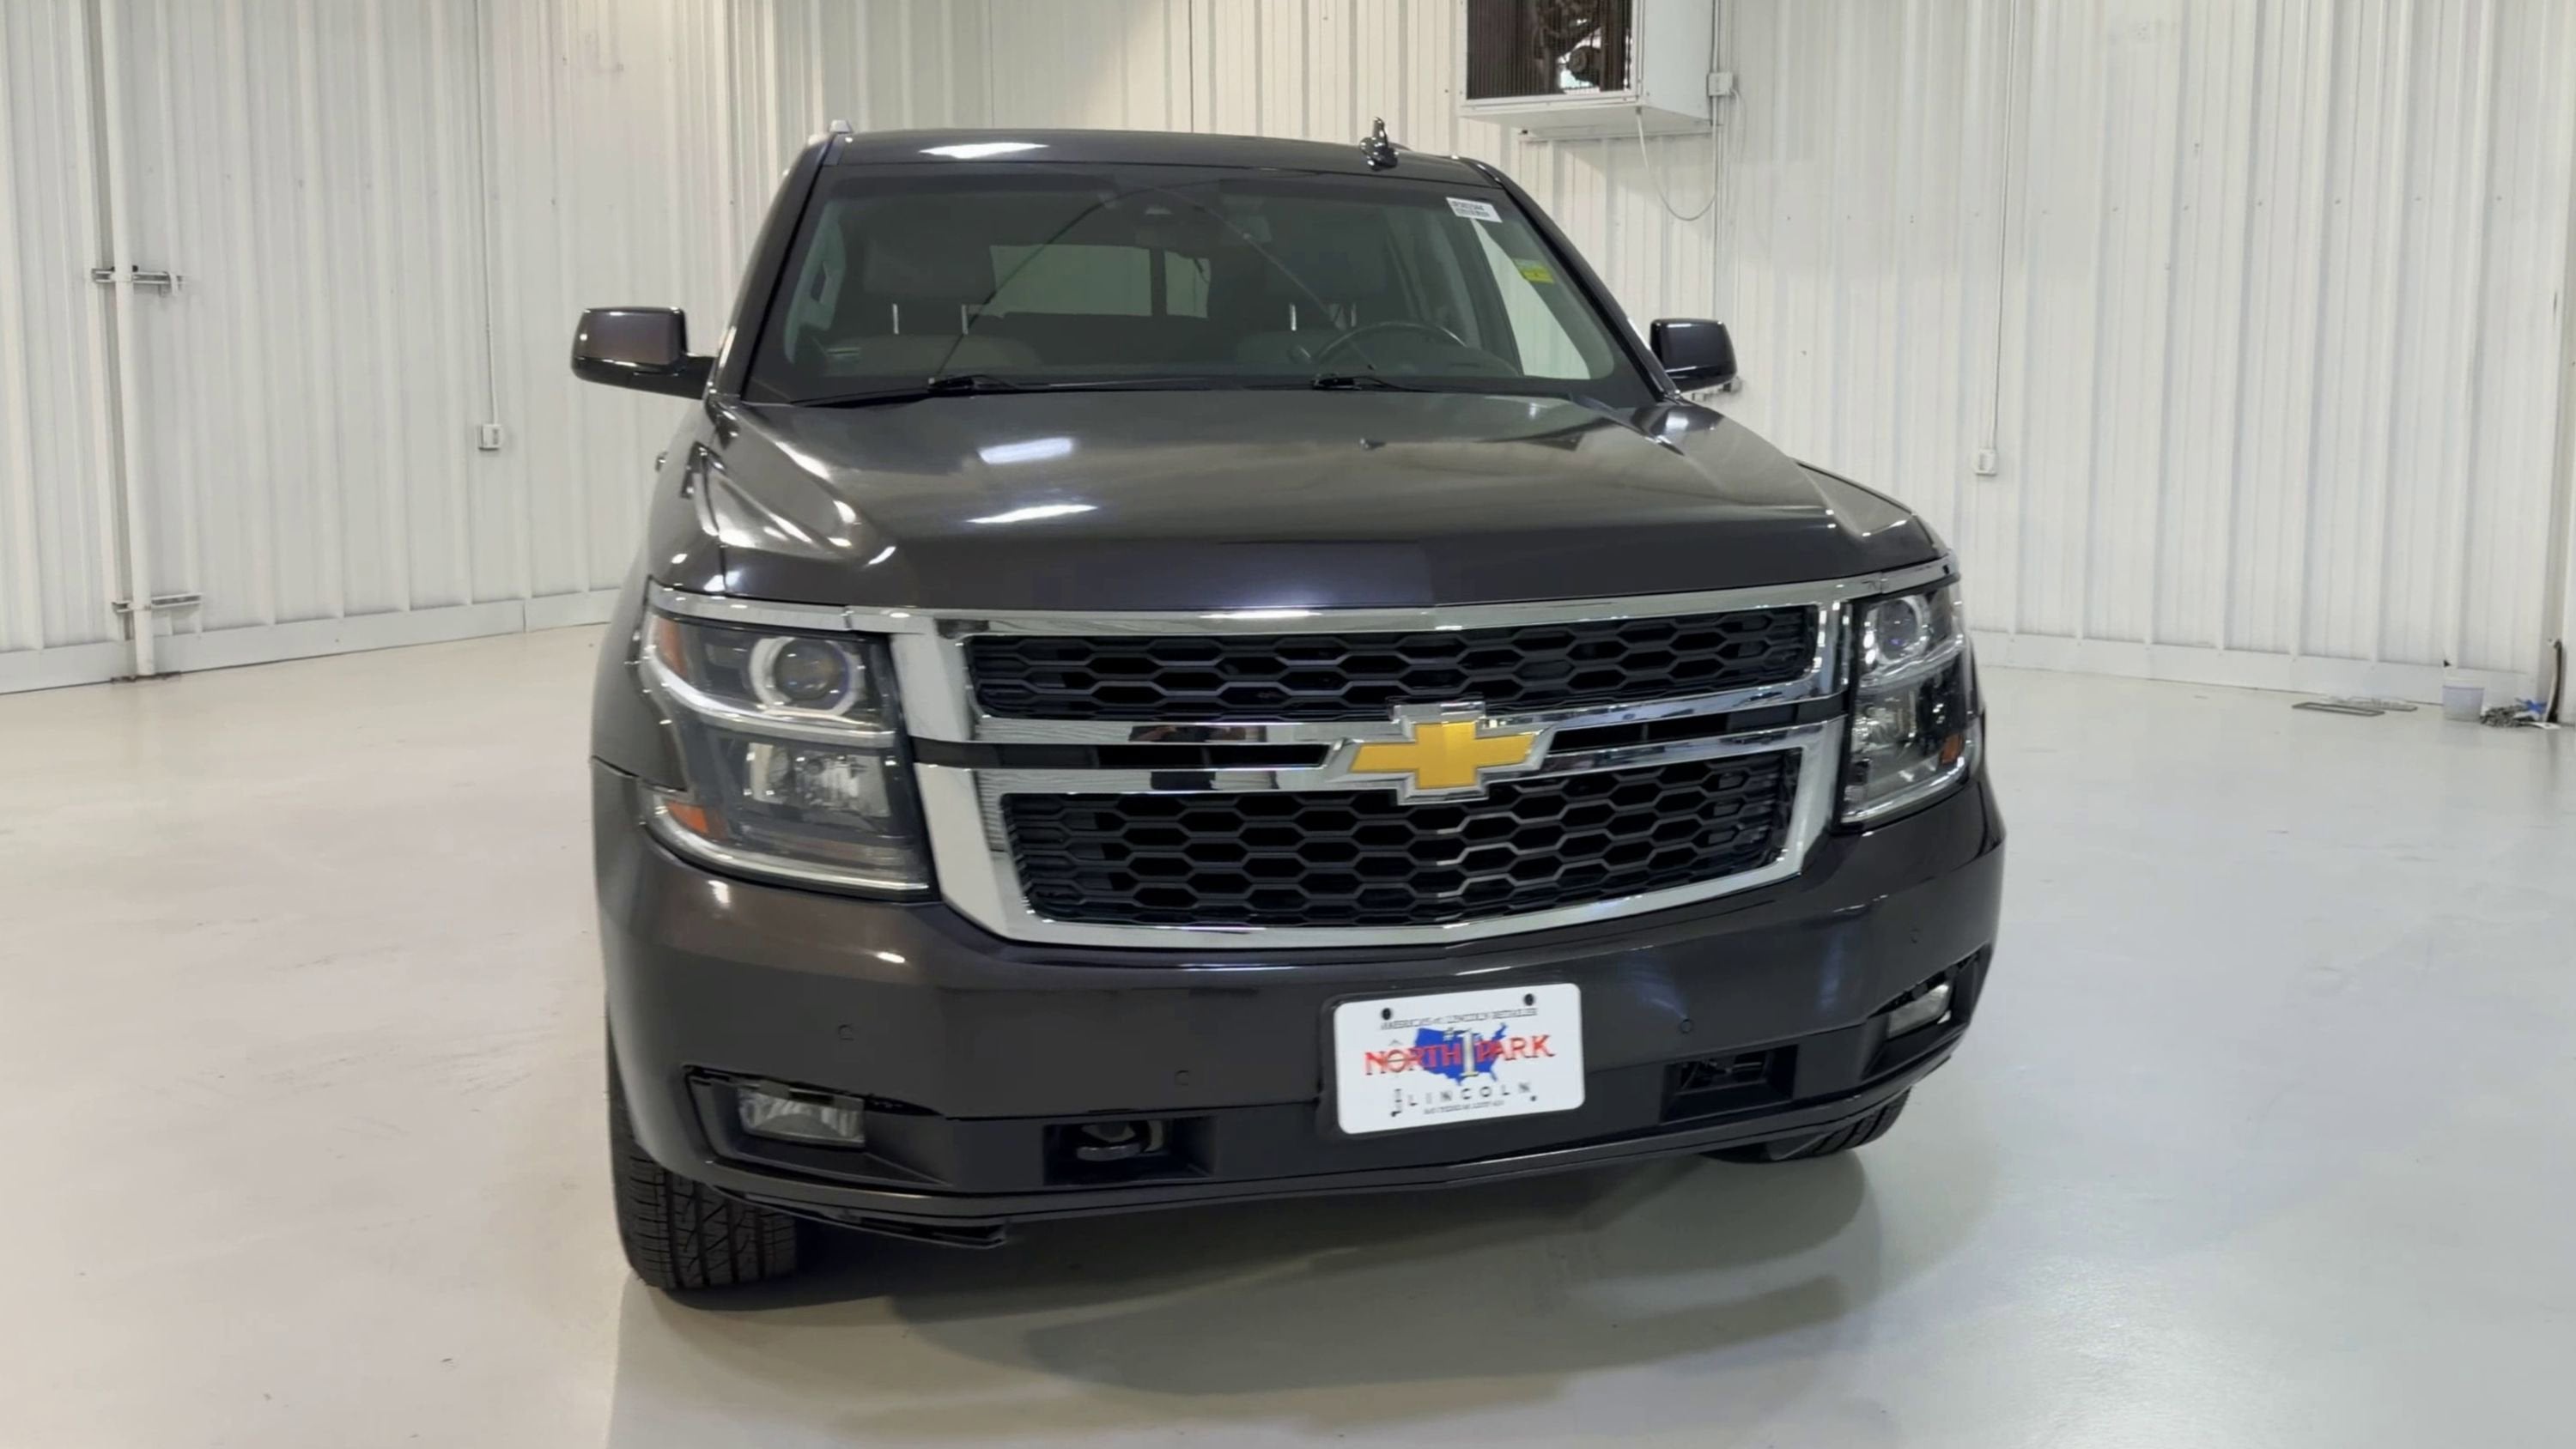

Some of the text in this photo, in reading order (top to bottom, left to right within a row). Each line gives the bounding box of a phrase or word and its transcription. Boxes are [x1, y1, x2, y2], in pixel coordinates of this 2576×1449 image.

[1364, 1034, 1555, 1076] NORTH PARK
[1407, 1082, 1531, 1106] LINCOLN
